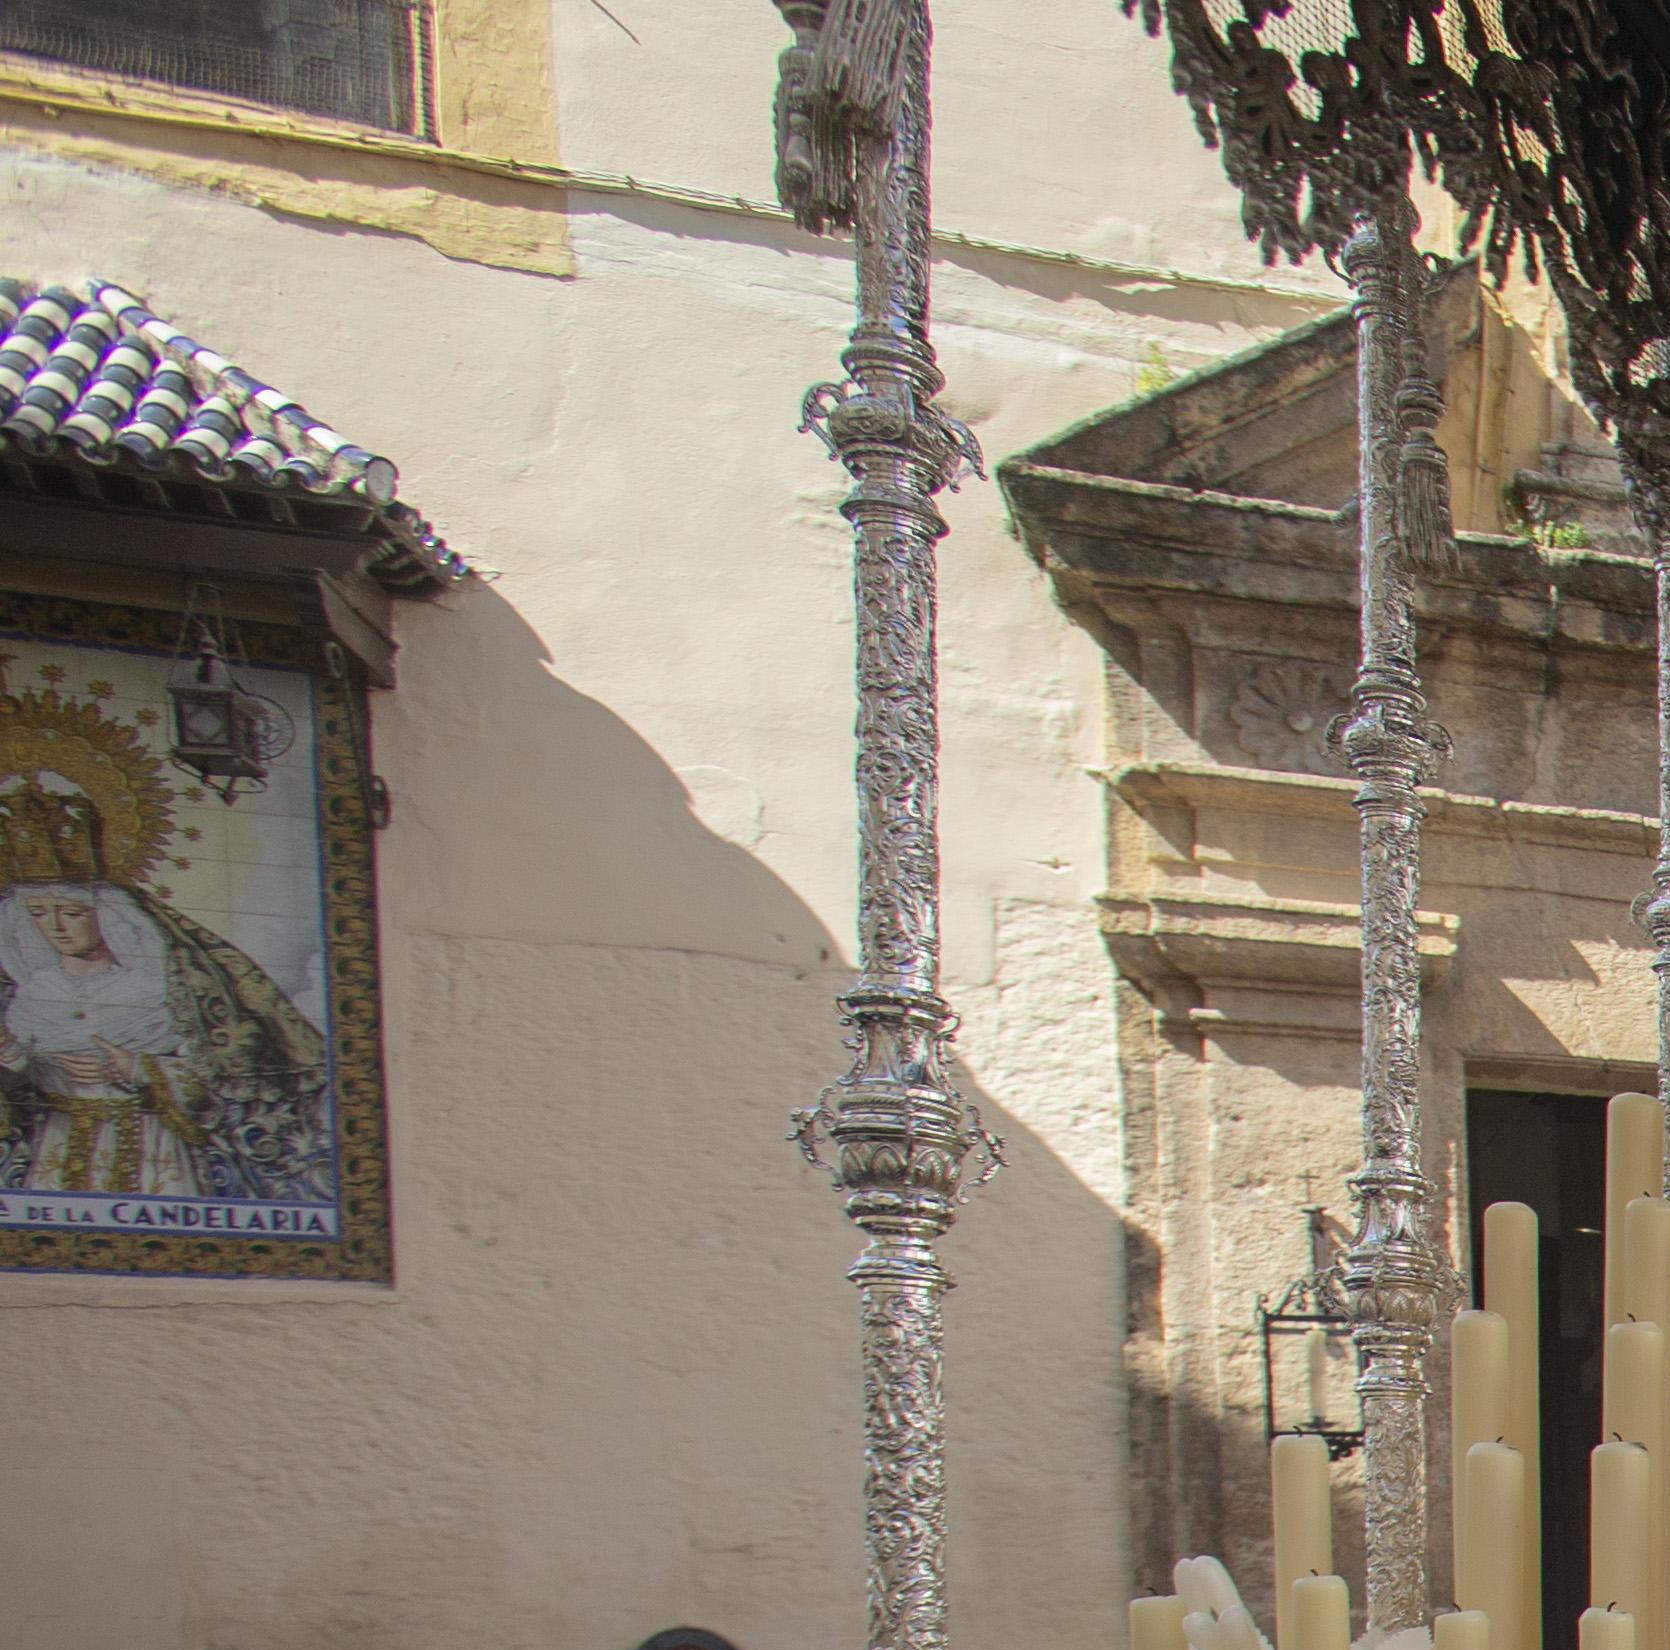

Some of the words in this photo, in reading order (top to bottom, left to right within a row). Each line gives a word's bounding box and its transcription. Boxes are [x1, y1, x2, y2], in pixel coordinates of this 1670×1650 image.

[27, 1206, 55, 1221] DE
[65, 1207, 95, 1223] LA
[111, 1203, 330, 1233] CANDELARIA
